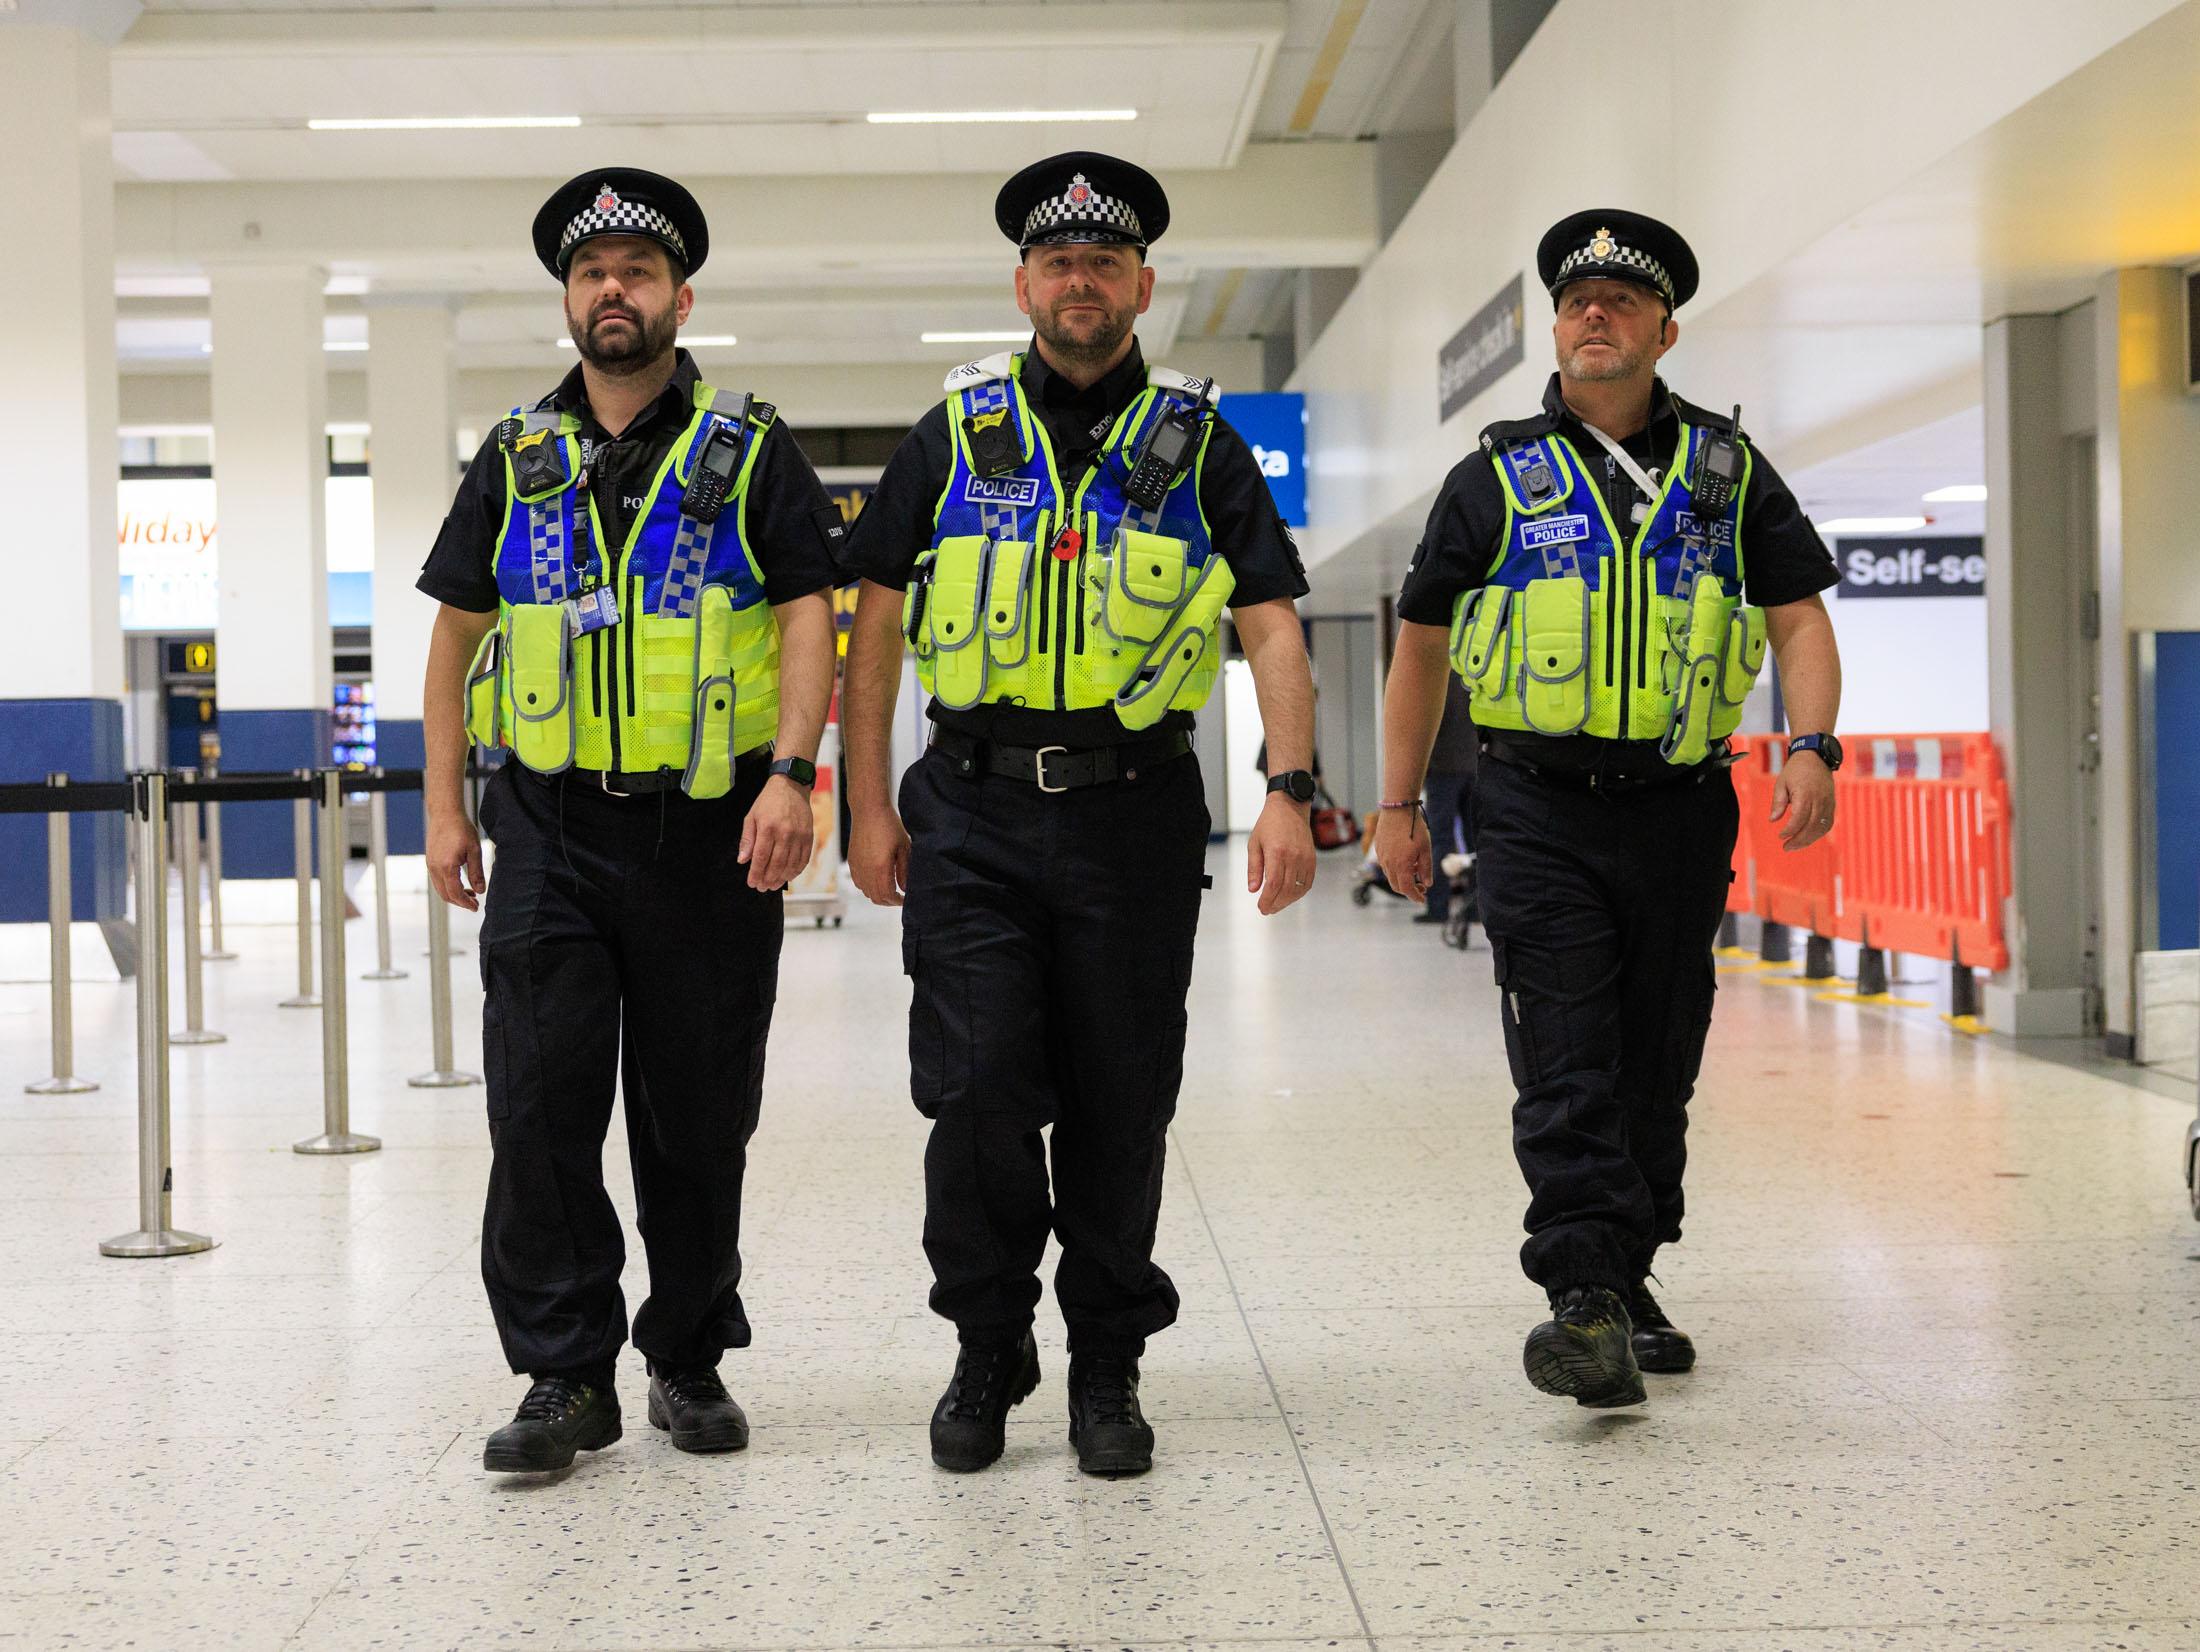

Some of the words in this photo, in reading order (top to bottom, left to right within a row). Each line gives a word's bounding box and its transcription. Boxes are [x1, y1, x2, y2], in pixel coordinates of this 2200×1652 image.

[761, 404, 774, 420] 2015
[502, 420, 510, 440] 2015
[972, 479, 1031, 500] POLICE
[623, 495, 647, 510] PO
[1525, 523, 1548, 534] GREATER
[1548, 518, 1584, 530] MANCHESTER
[1534, 526, 1577, 543] POLICE
[1683, 517, 1731, 540] POICE
[1846, 547, 1985, 586] Self-se
[604, 586, 621, 623] POLICE
